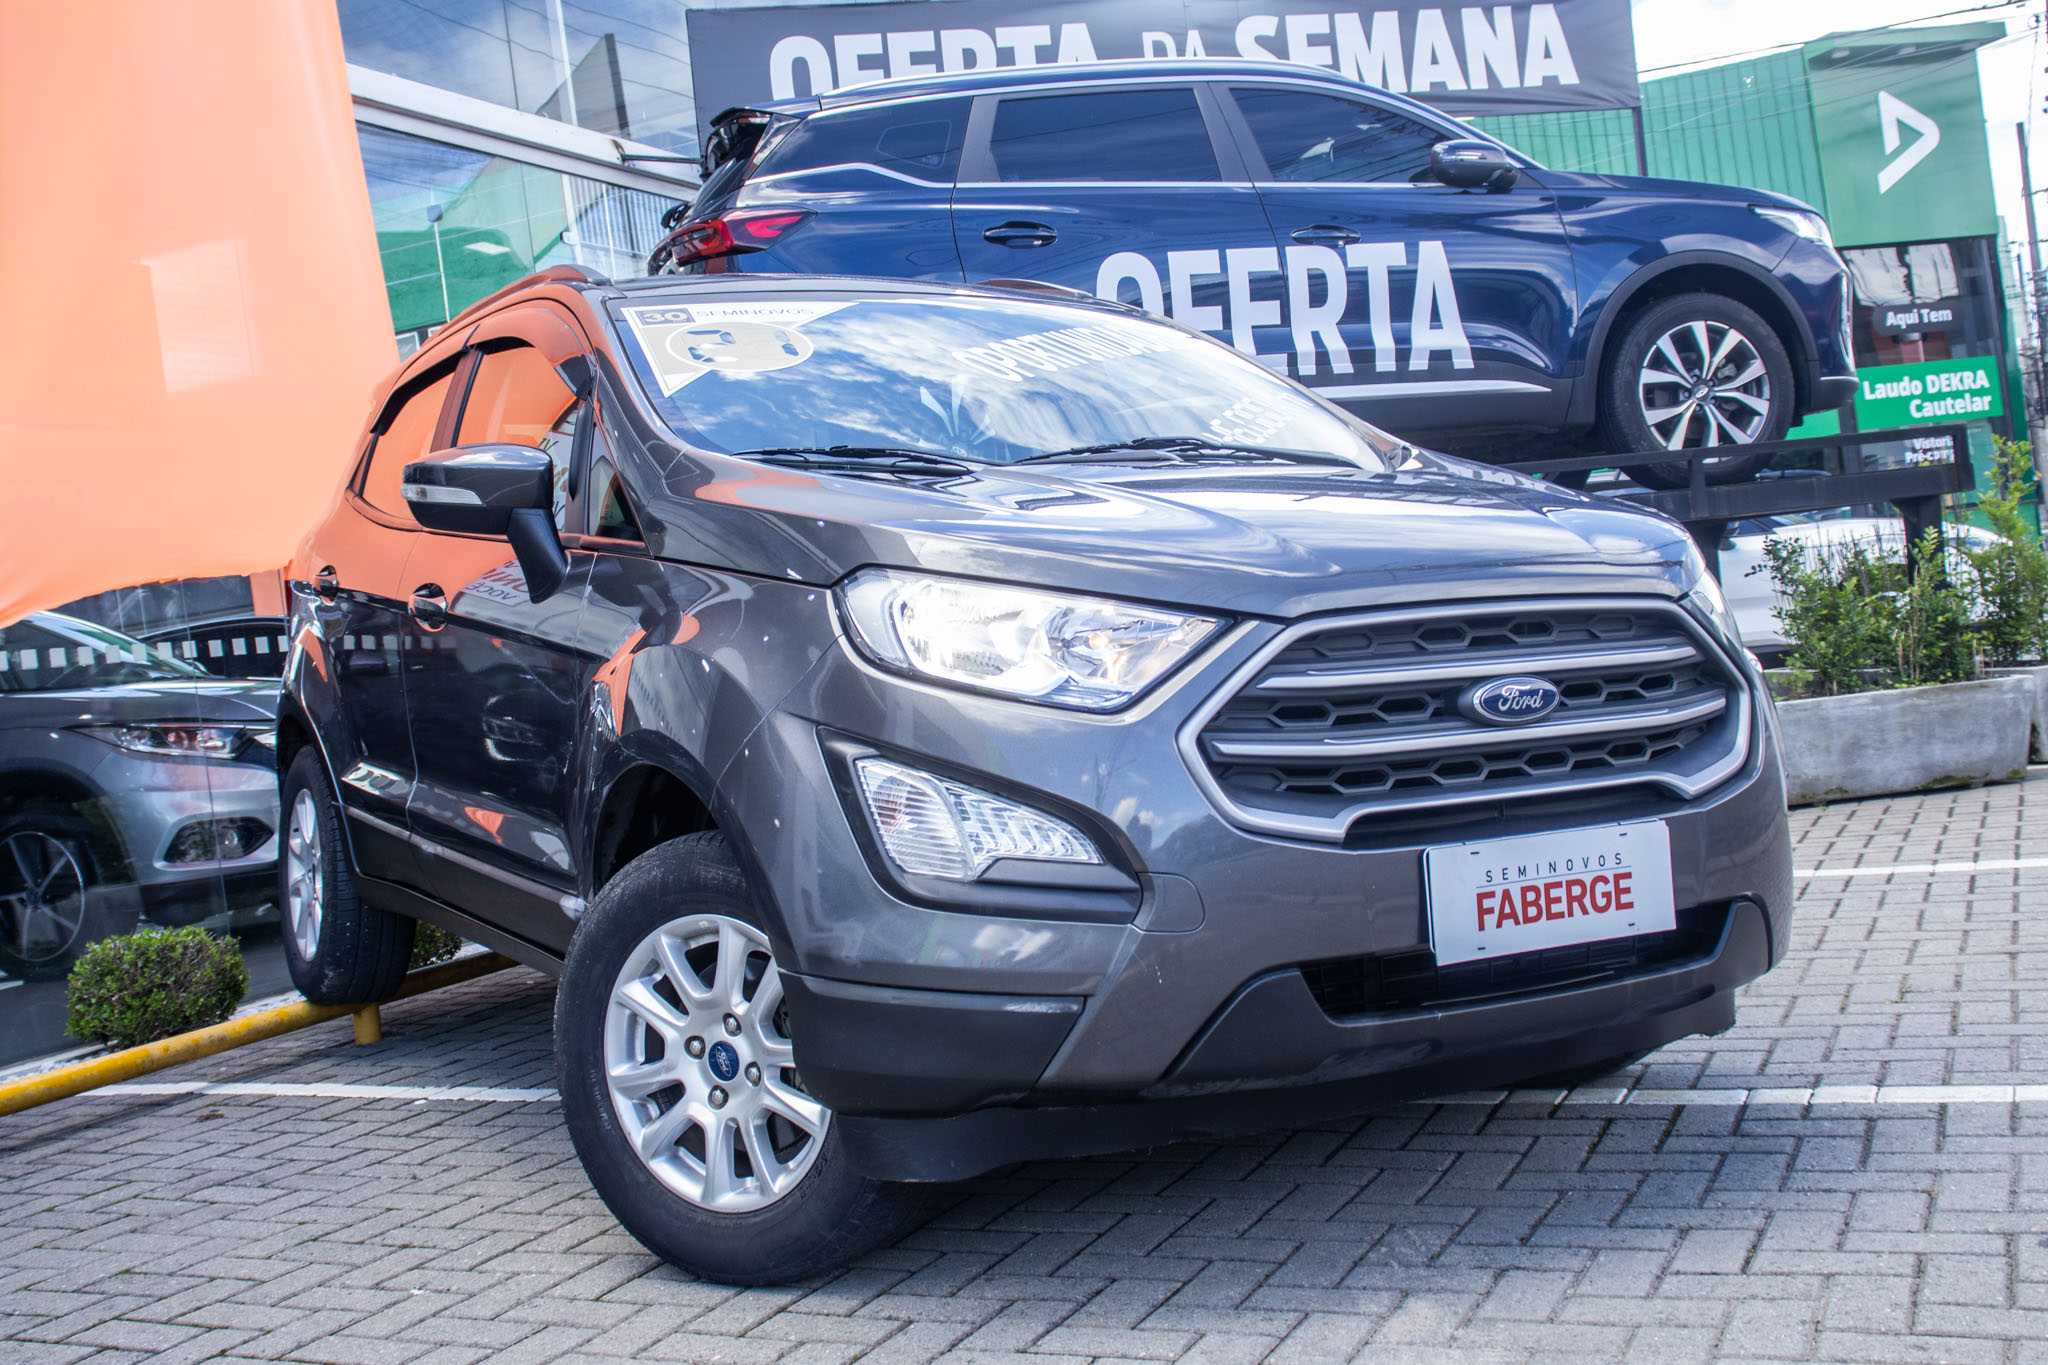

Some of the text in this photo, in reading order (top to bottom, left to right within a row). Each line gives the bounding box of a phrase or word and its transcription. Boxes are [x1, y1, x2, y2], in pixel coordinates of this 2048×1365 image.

[1235, 3, 1580, 93] SEMANA
[1885, 308, 1953, 329] Aqui Tem
[951, 325, 1176, 383] OPORTUNIDAD
[1862, 369, 1991, 400] Laudo DEKRA
[1909, 393, 1993, 418] Cautelar
[1498, 685, 1544, 711] Ford
[1485, 852, 1622, 883] SEMINOVOS
[1476, 871, 1635, 932] FABERGE
